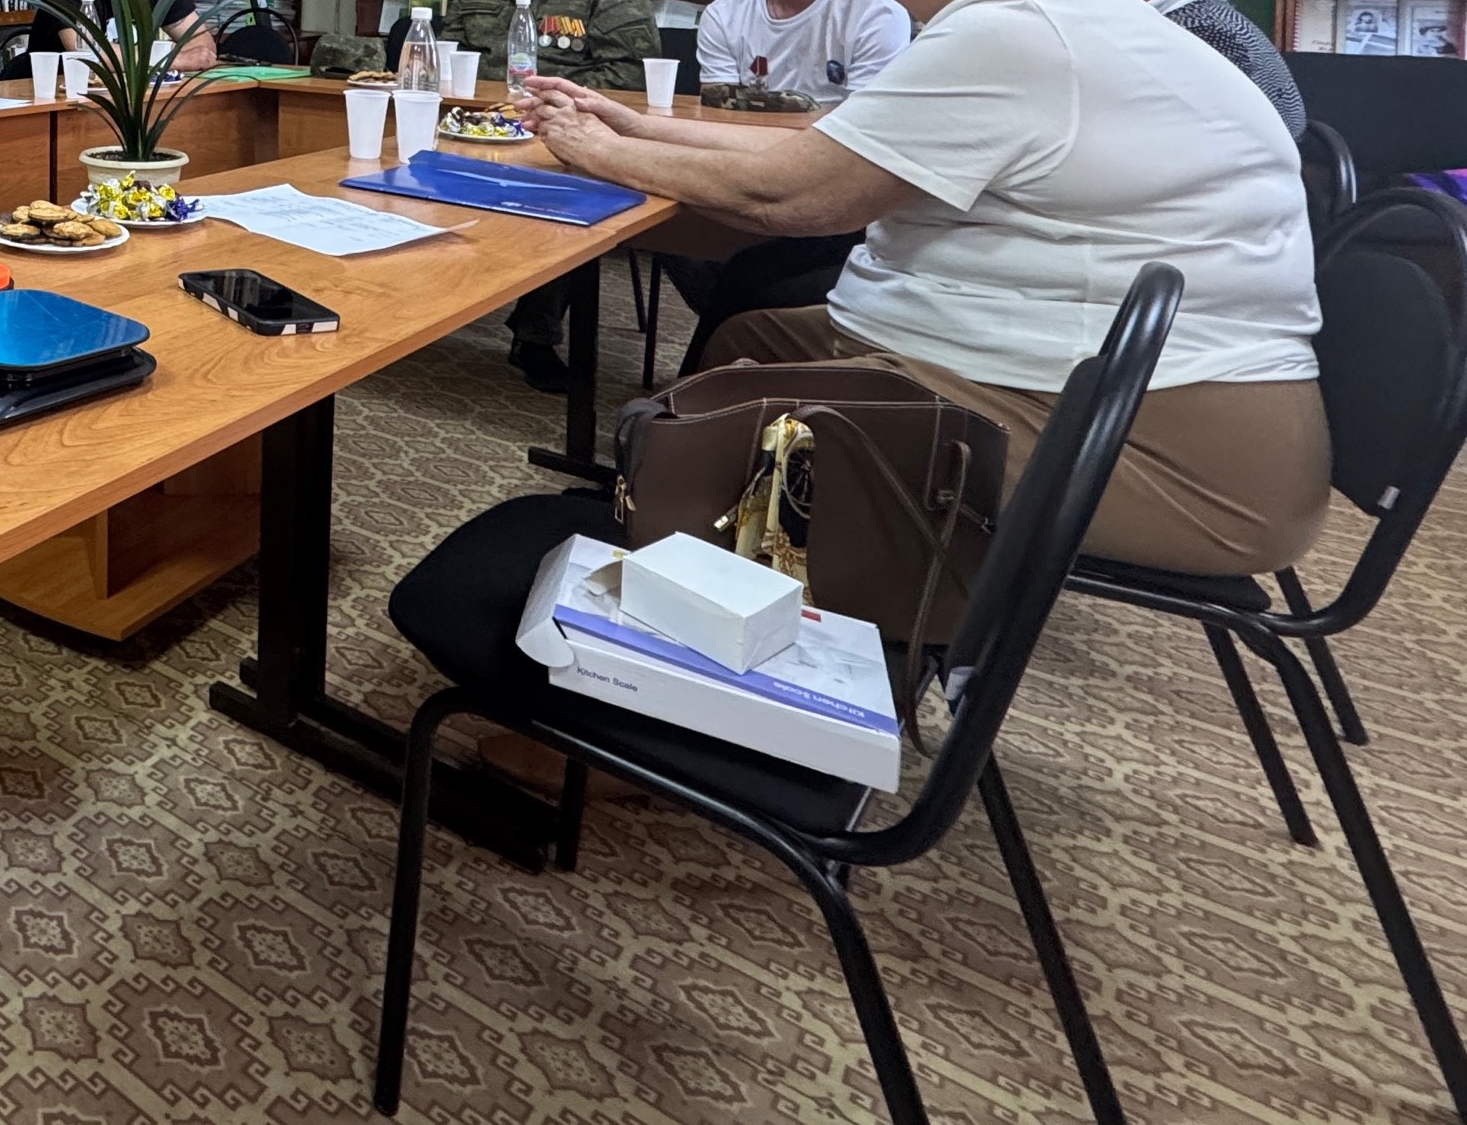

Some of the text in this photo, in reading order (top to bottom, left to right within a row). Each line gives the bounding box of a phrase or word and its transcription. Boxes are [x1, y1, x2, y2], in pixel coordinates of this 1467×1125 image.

[577, 666, 638, 692] Kitchen Scale
[813, 694, 865, 718] Kitchen
